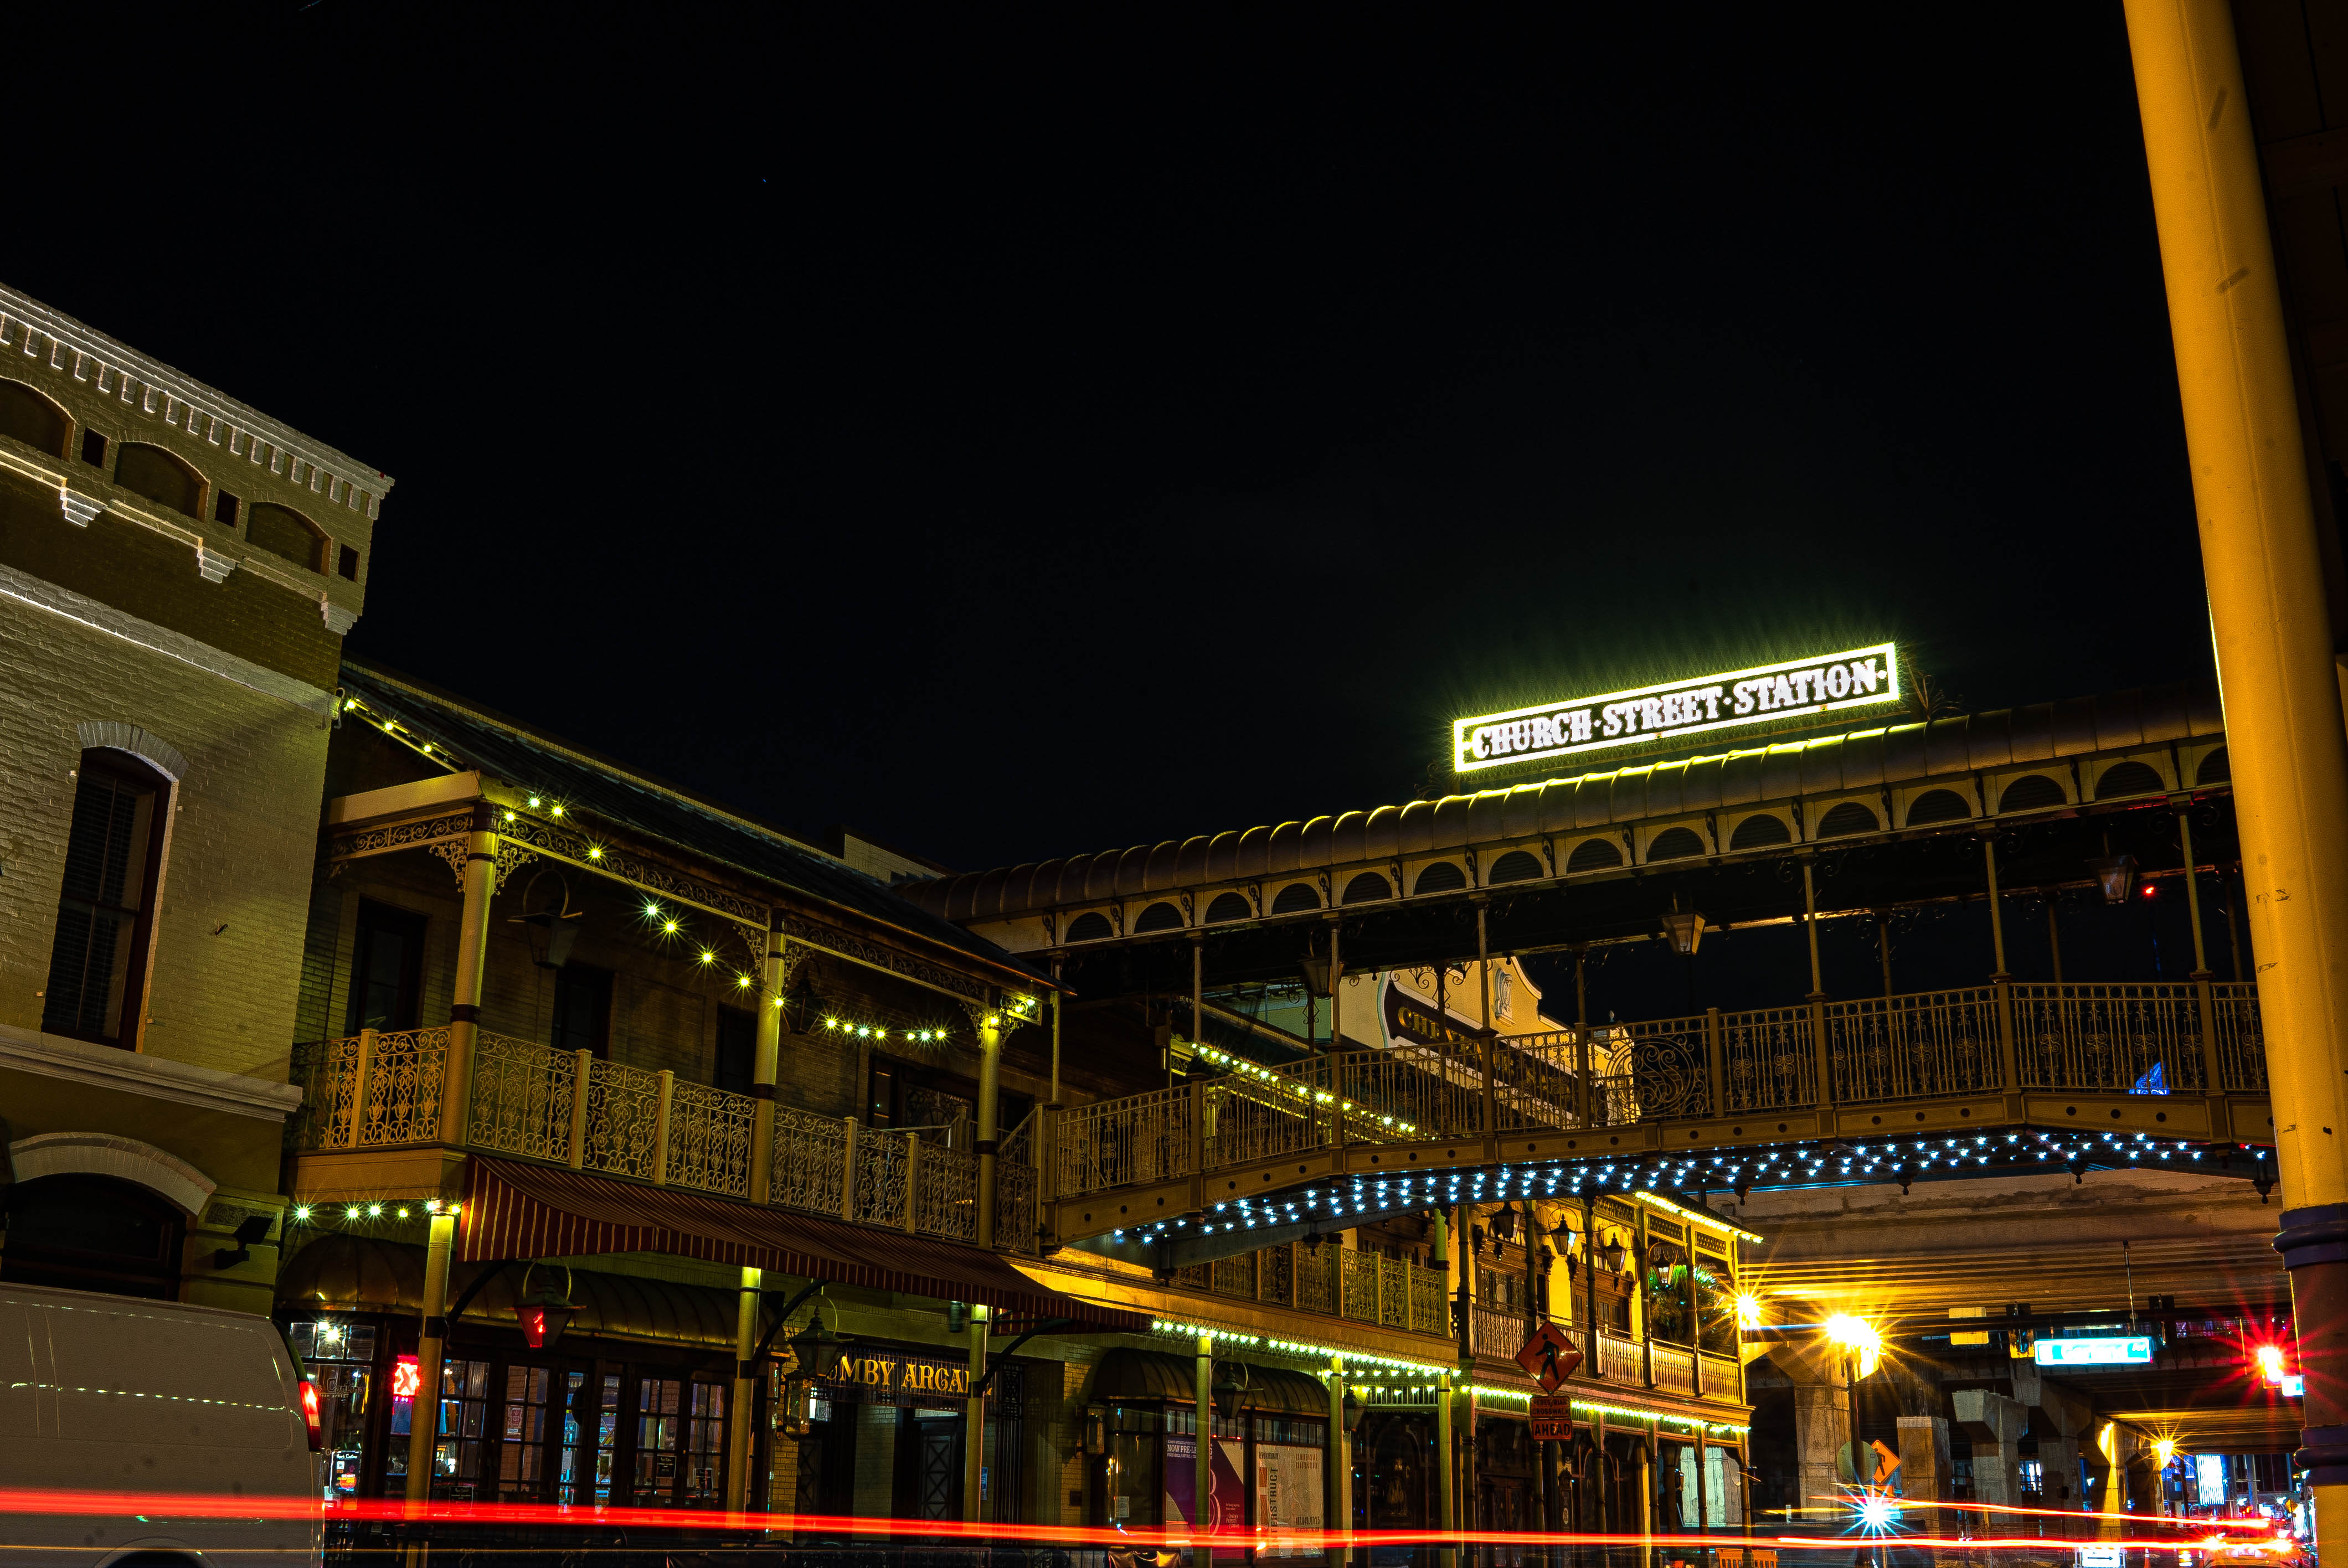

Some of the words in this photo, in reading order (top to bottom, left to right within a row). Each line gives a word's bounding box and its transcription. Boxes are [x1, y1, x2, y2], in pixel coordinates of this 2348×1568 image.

[1472, 709, 1593, 759] CHURCH
[1602, 686, 1723, 737] STREET
[1733, 658, 1877, 715] STATION
[901, 1363, 993, 1396] ARCA
[1535, 1422, 1570, 1436] AHEAD
[1167, 1444, 1180, 1453] NOW
